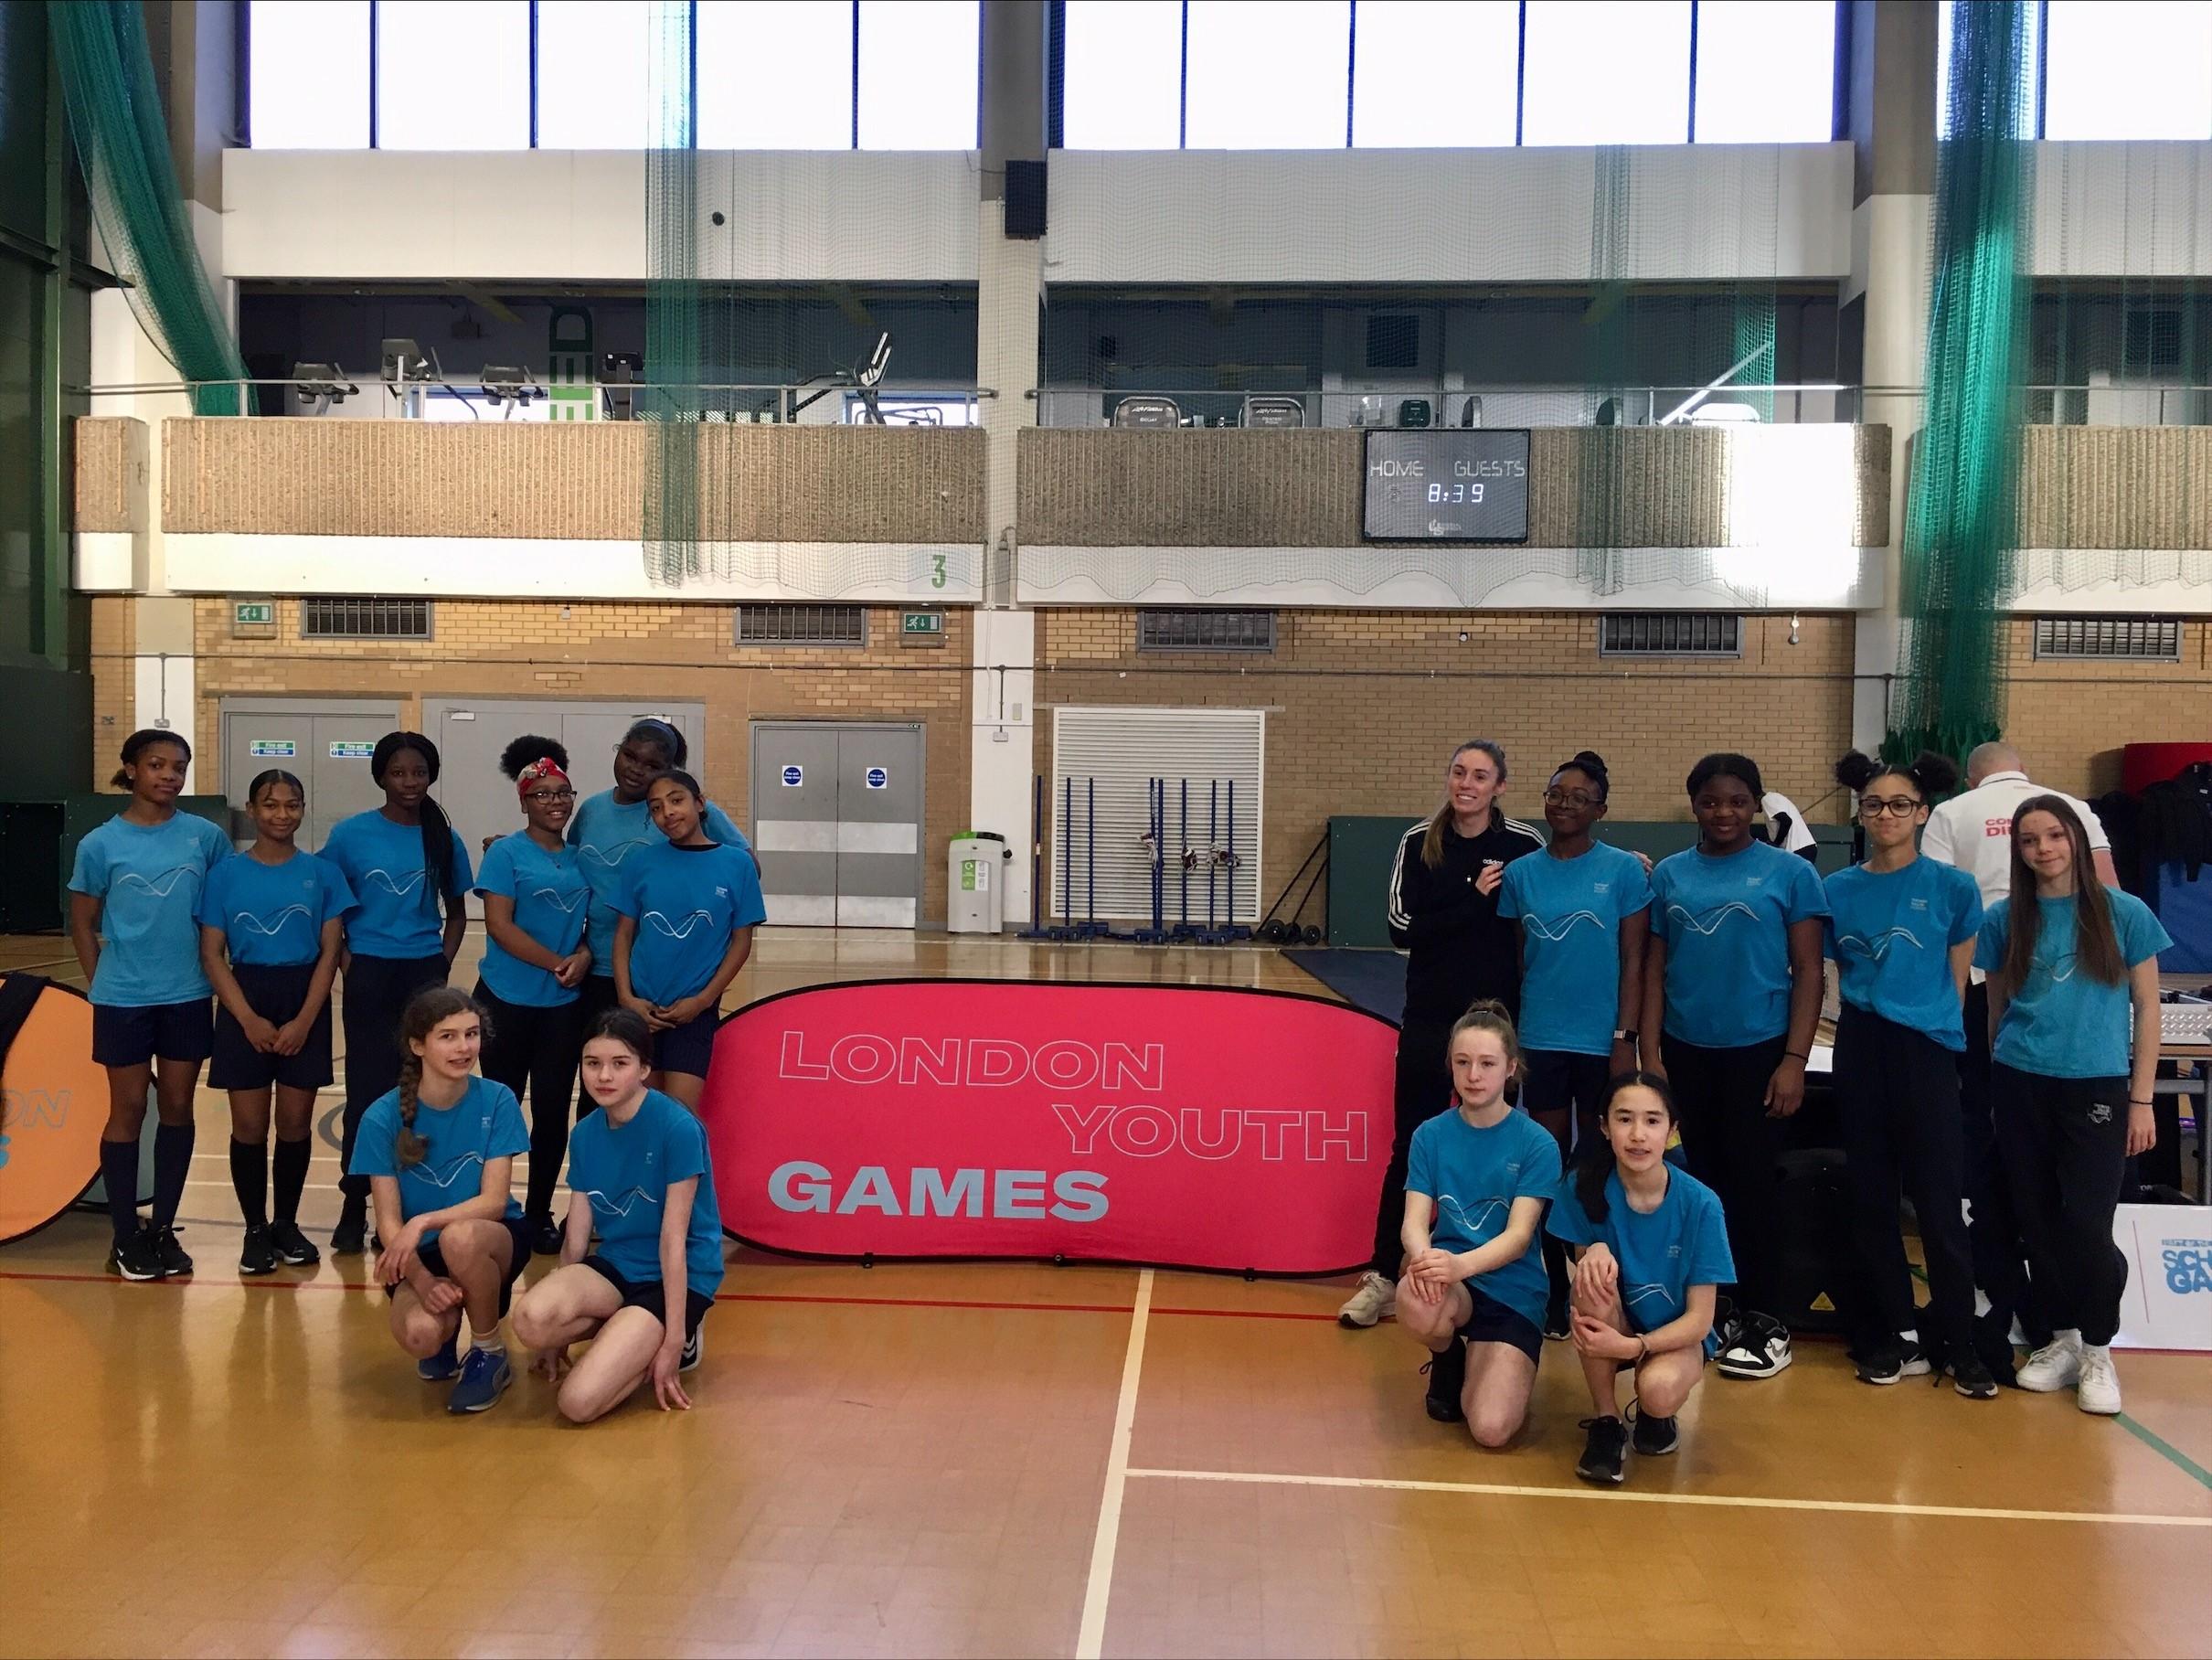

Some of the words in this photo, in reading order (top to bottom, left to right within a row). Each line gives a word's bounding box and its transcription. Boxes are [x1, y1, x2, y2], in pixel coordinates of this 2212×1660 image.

[1370, 460, 1424, 476] HOME
[1454, 460, 1526, 477] GUESTS
[1428, 483, 1484, 503] 8:39
[932, 554, 946, 589] 3
[780, 1030, 1164, 1091] LONDON
[1051, 1104, 1367, 1162] YOUTH
[768, 1160, 1110, 1223] GAMES
